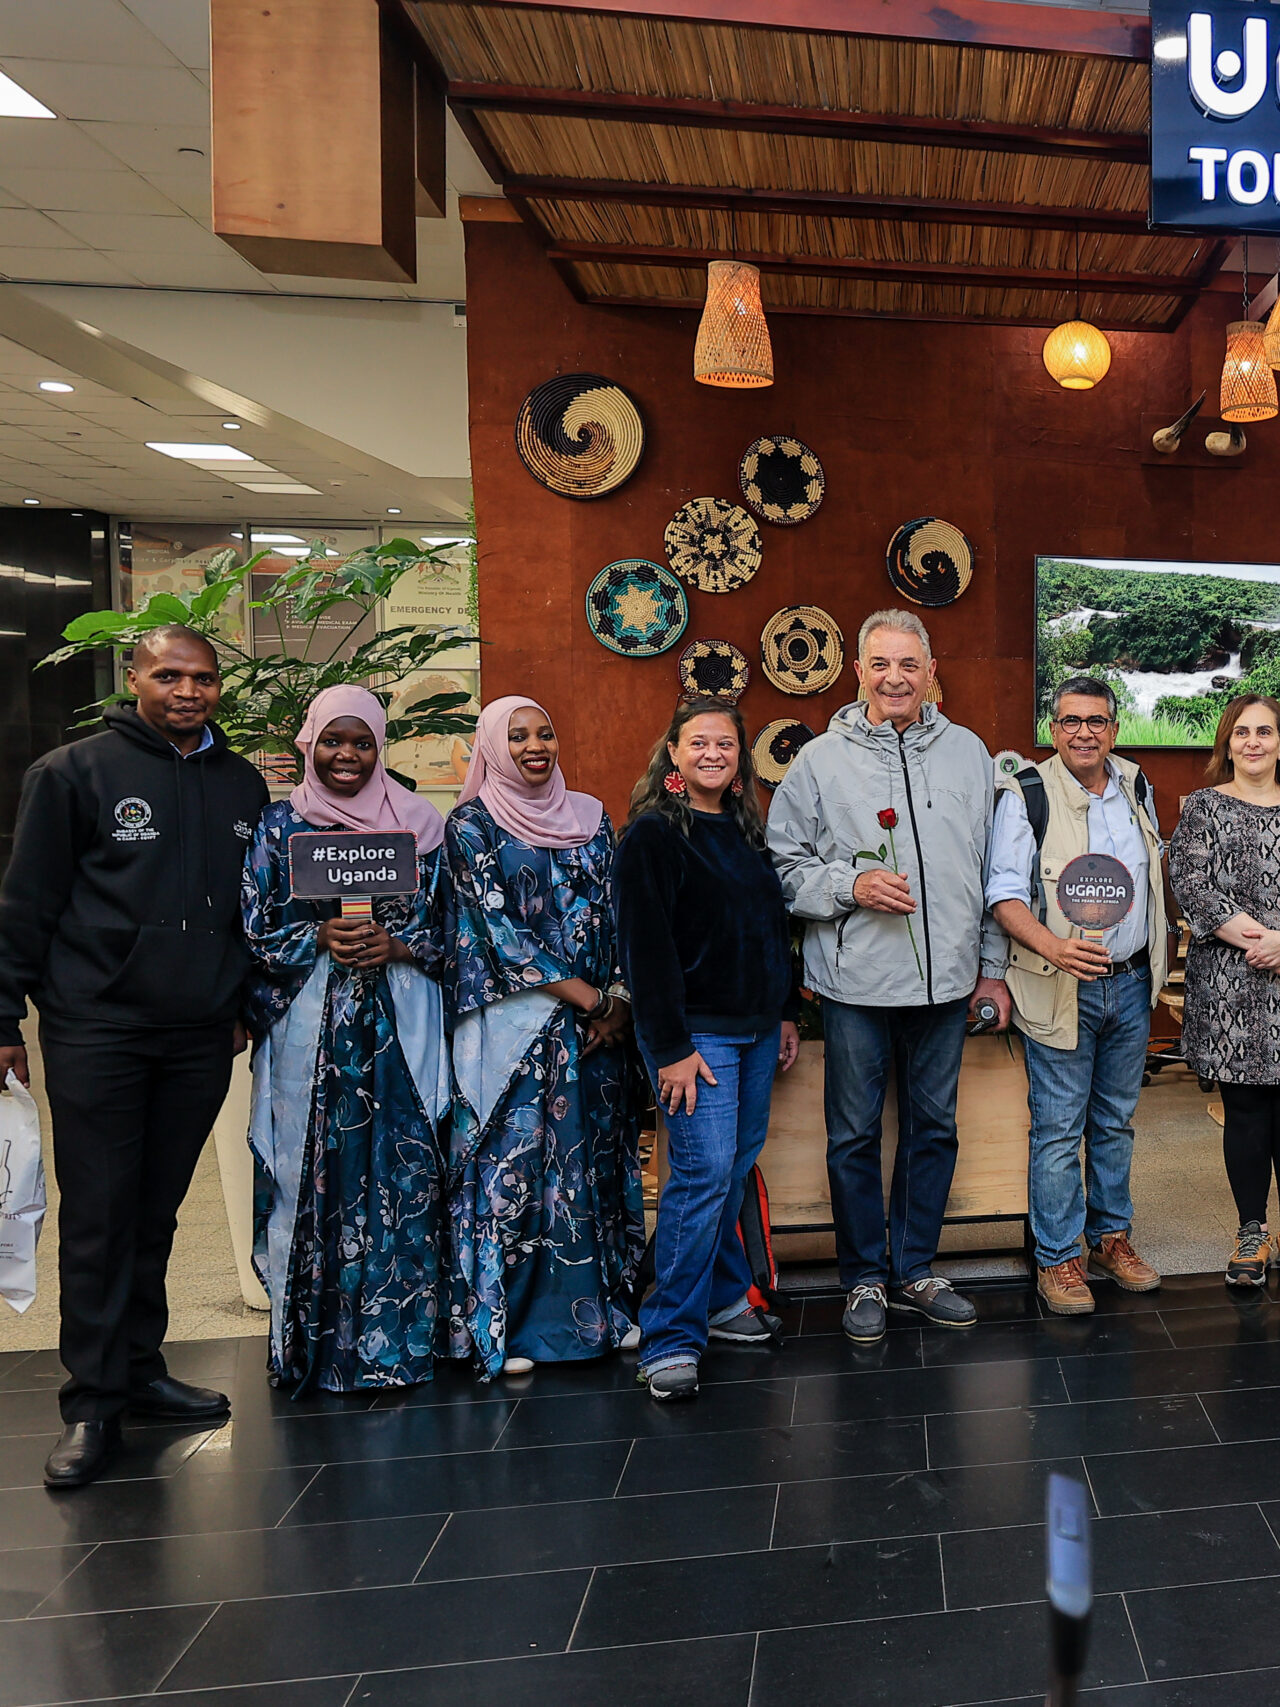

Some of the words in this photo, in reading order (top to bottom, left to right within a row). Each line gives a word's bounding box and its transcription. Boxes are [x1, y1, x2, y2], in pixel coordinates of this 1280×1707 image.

[390, 606, 452, 614] EMERGENCY
[312, 845, 395, 864] #Explore
[328, 866, 397, 886] Uganda
[1079, 876, 1113, 884] EXPLORE
[1065, 884, 1126, 898] UGANDA
